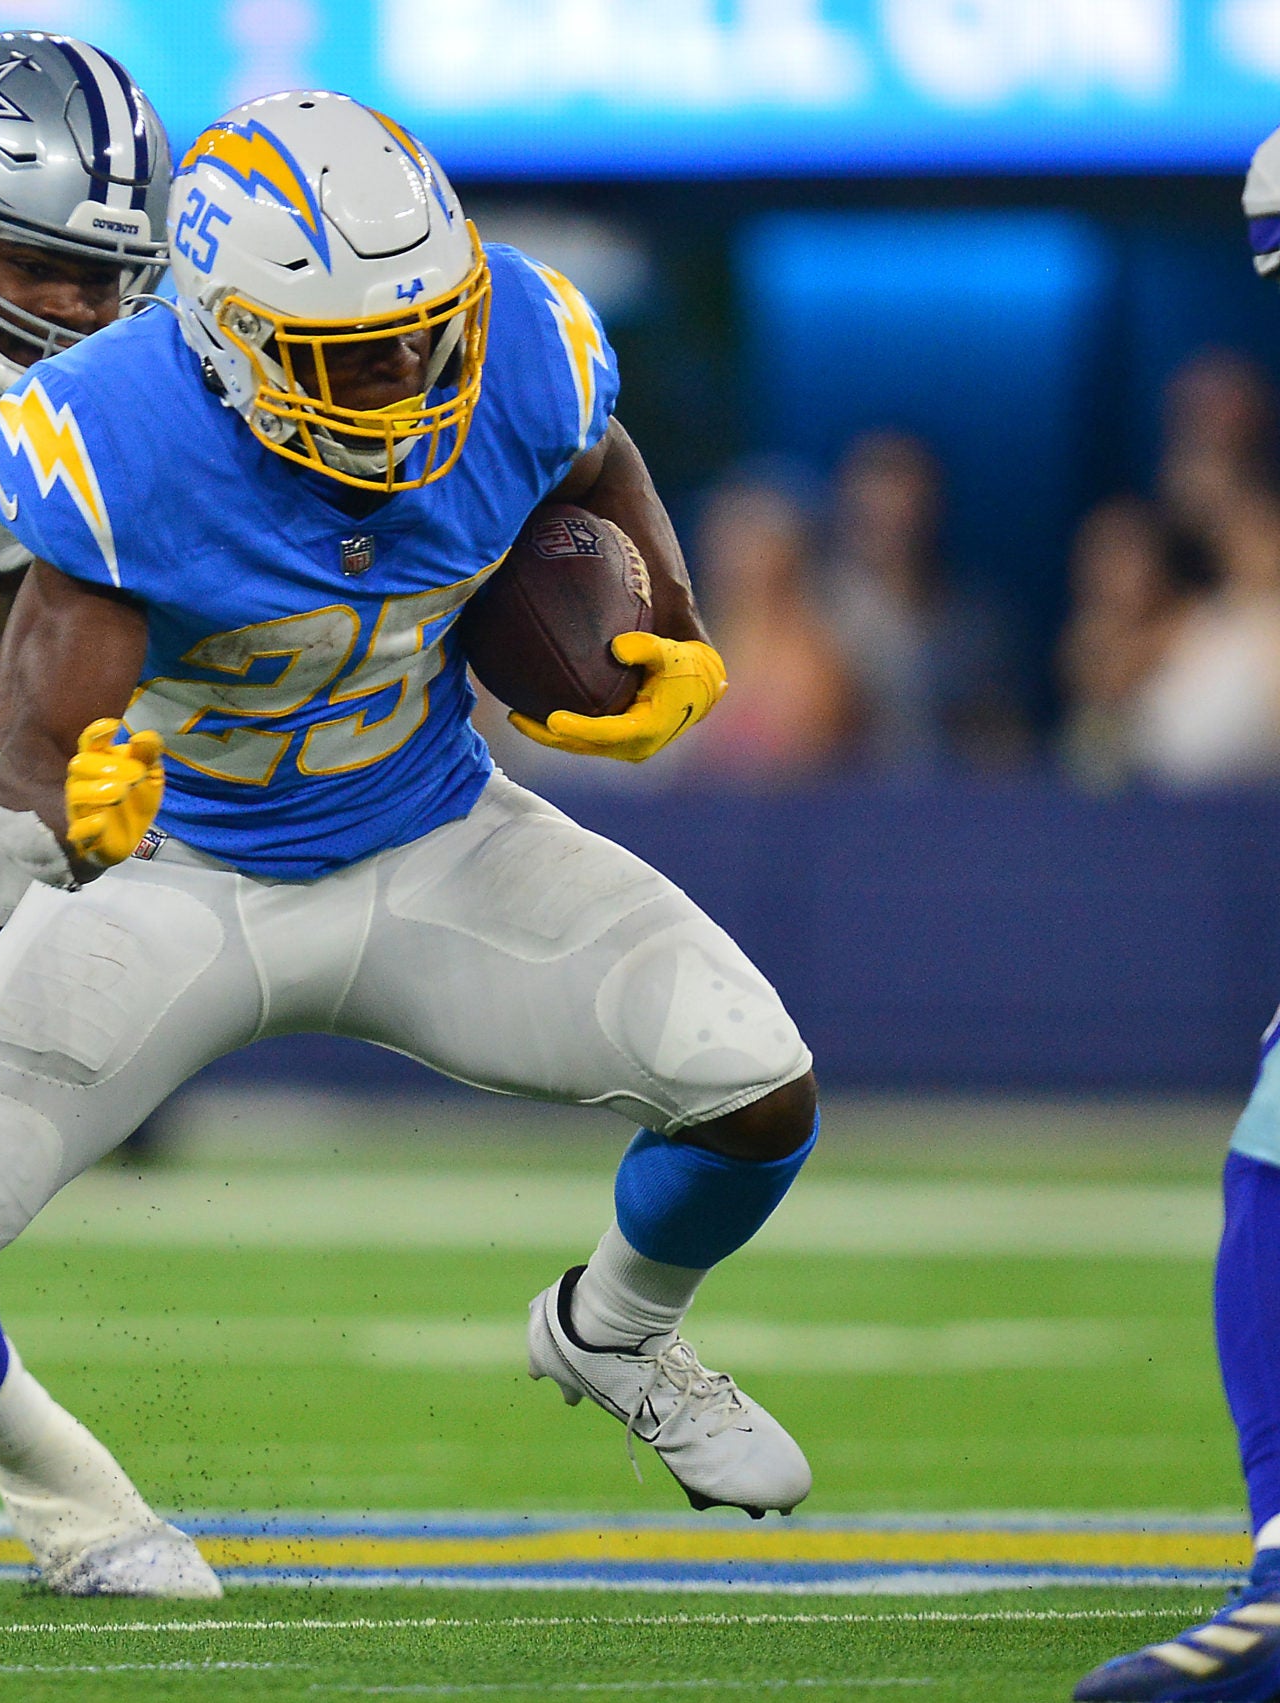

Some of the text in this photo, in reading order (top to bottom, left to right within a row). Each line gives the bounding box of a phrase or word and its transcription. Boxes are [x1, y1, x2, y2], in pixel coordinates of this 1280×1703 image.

[92, 217, 139, 235] COWBOYS
[175, 187, 232, 274] 25
[120, 546, 513, 787] 25
